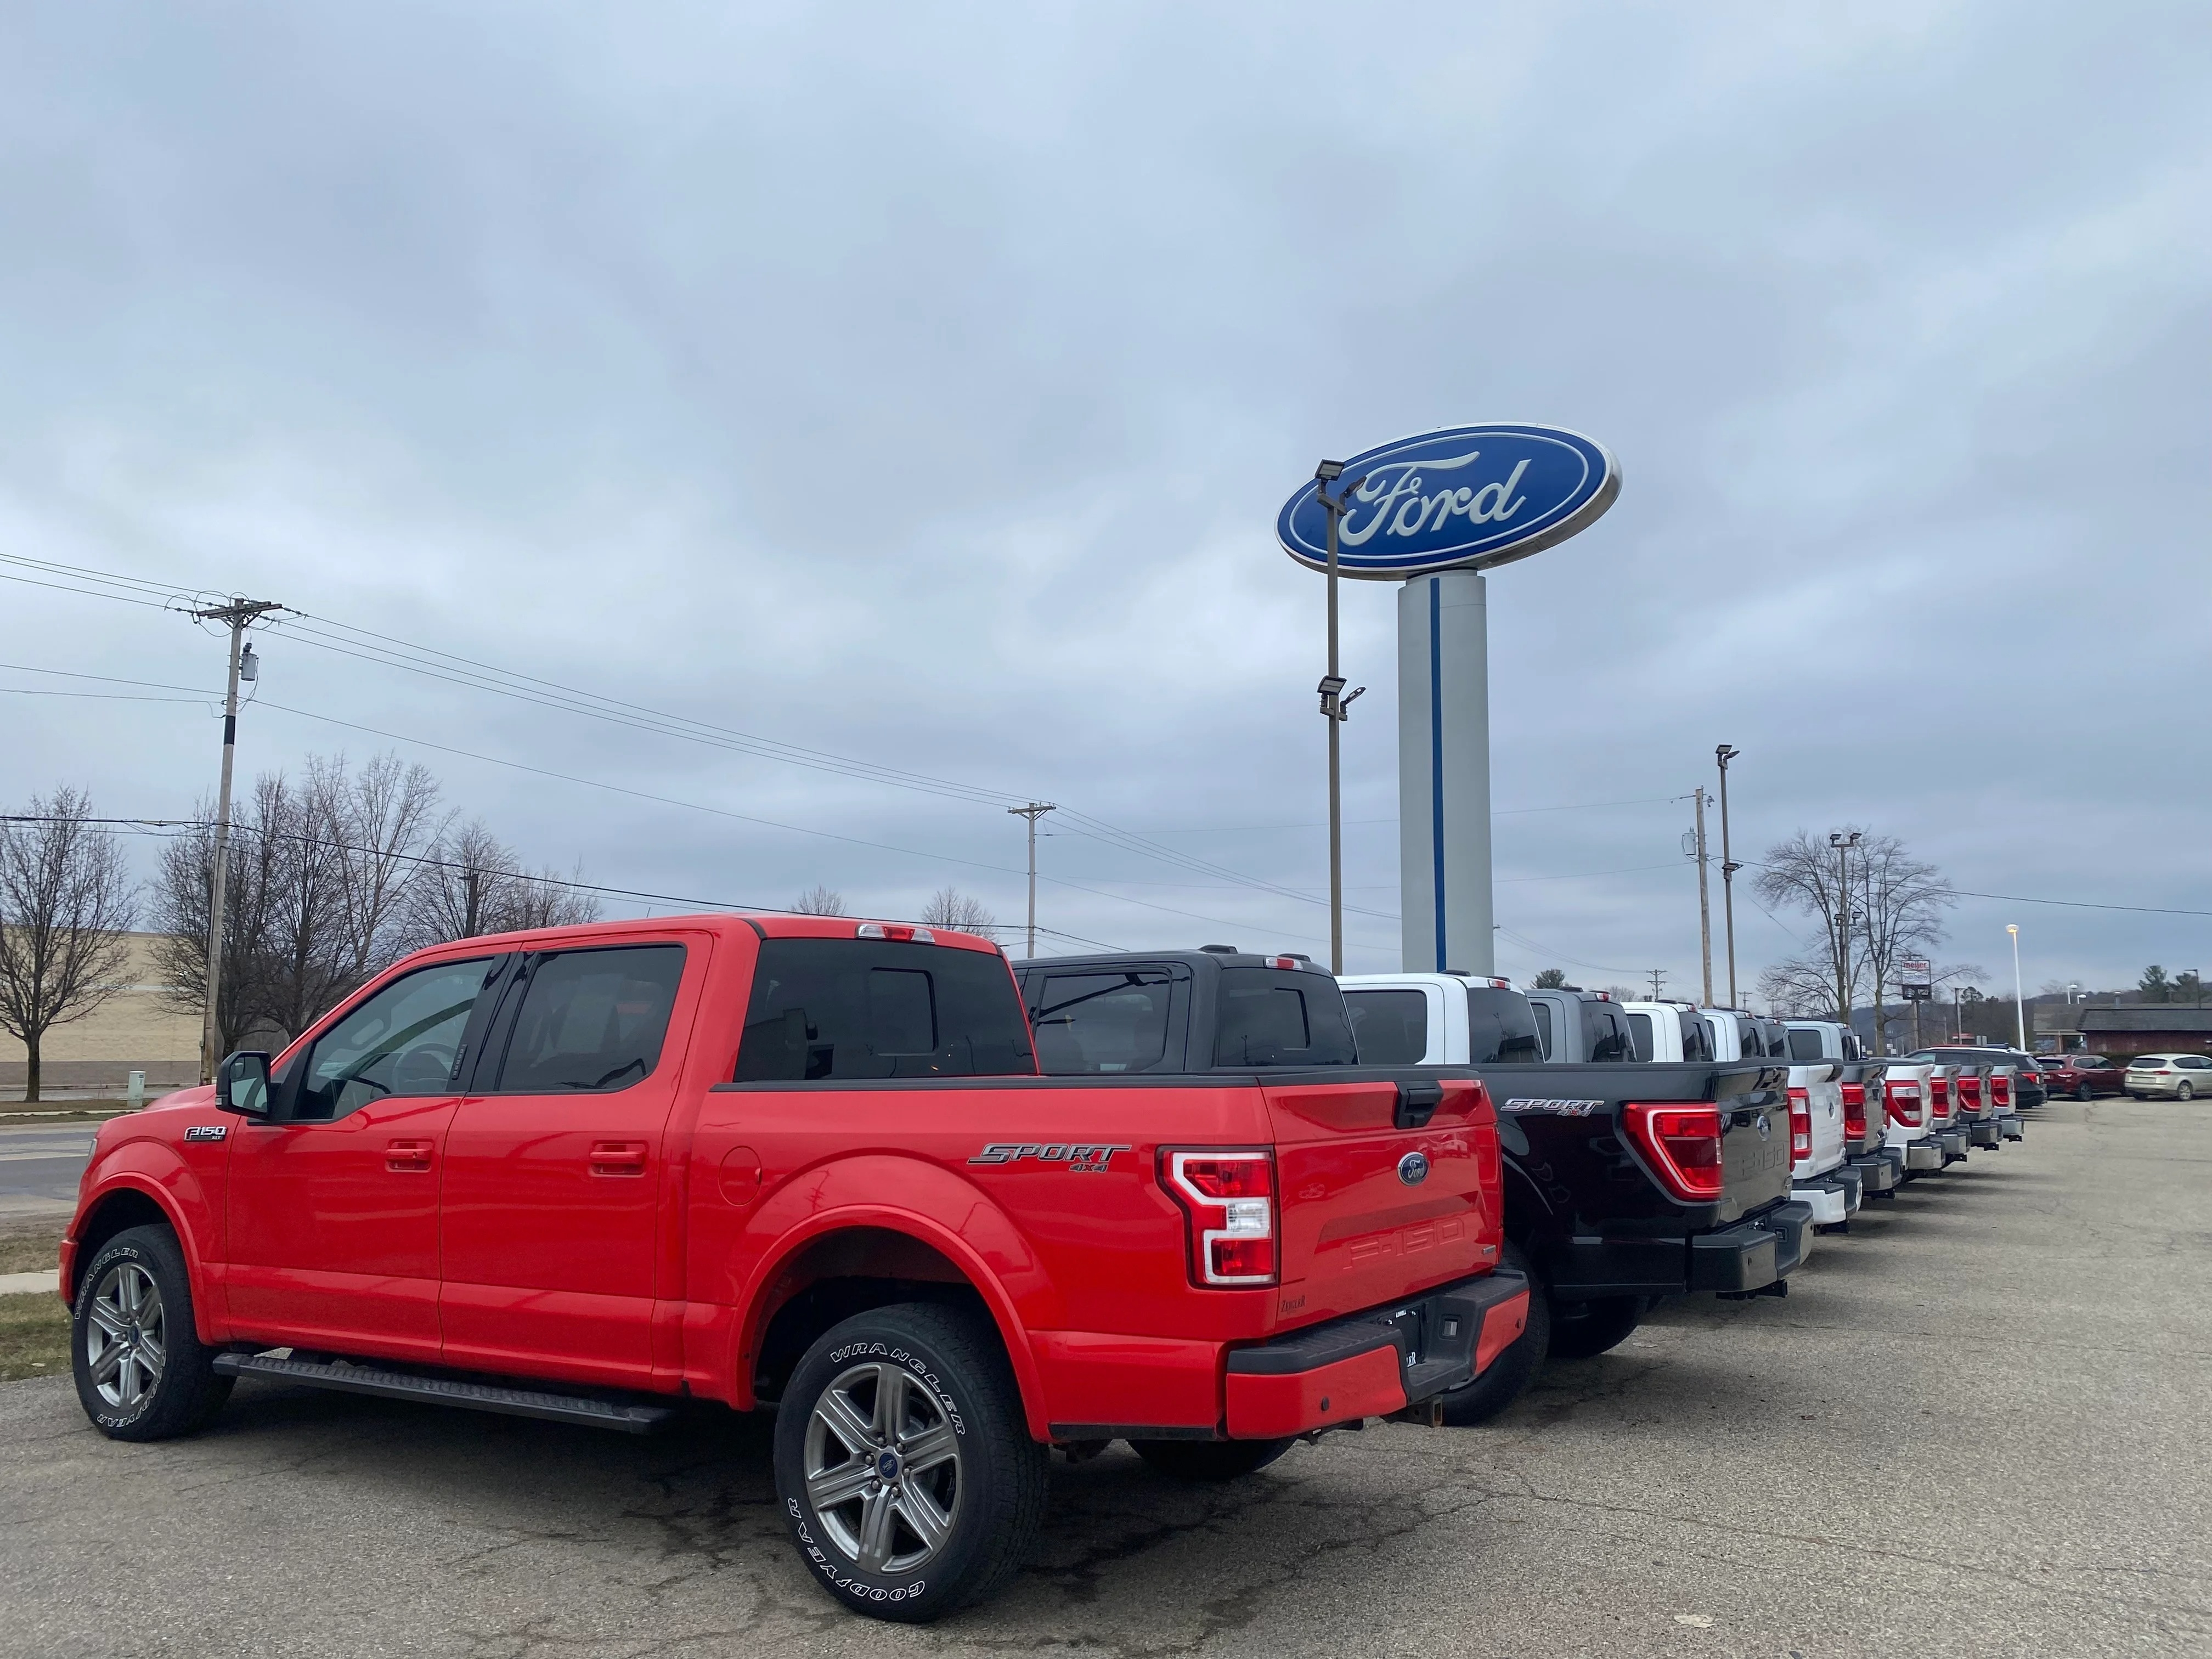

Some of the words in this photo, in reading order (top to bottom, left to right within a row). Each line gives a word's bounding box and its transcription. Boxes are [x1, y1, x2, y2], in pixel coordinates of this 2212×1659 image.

[1338, 451, 1532, 546] Ford
[1500, 1098, 1605, 1111] SPORT
[967, 1143, 1132, 1165] SPORT
[1408, 1159, 1425, 1179] Ford
[1342, 1218, 1465, 1270] F-150
[74, 1247, 139, 1320] WRANGLER
[830, 1342, 966, 1436] WRANGLER
[788, 1498, 926, 1601] GOODYEAR
